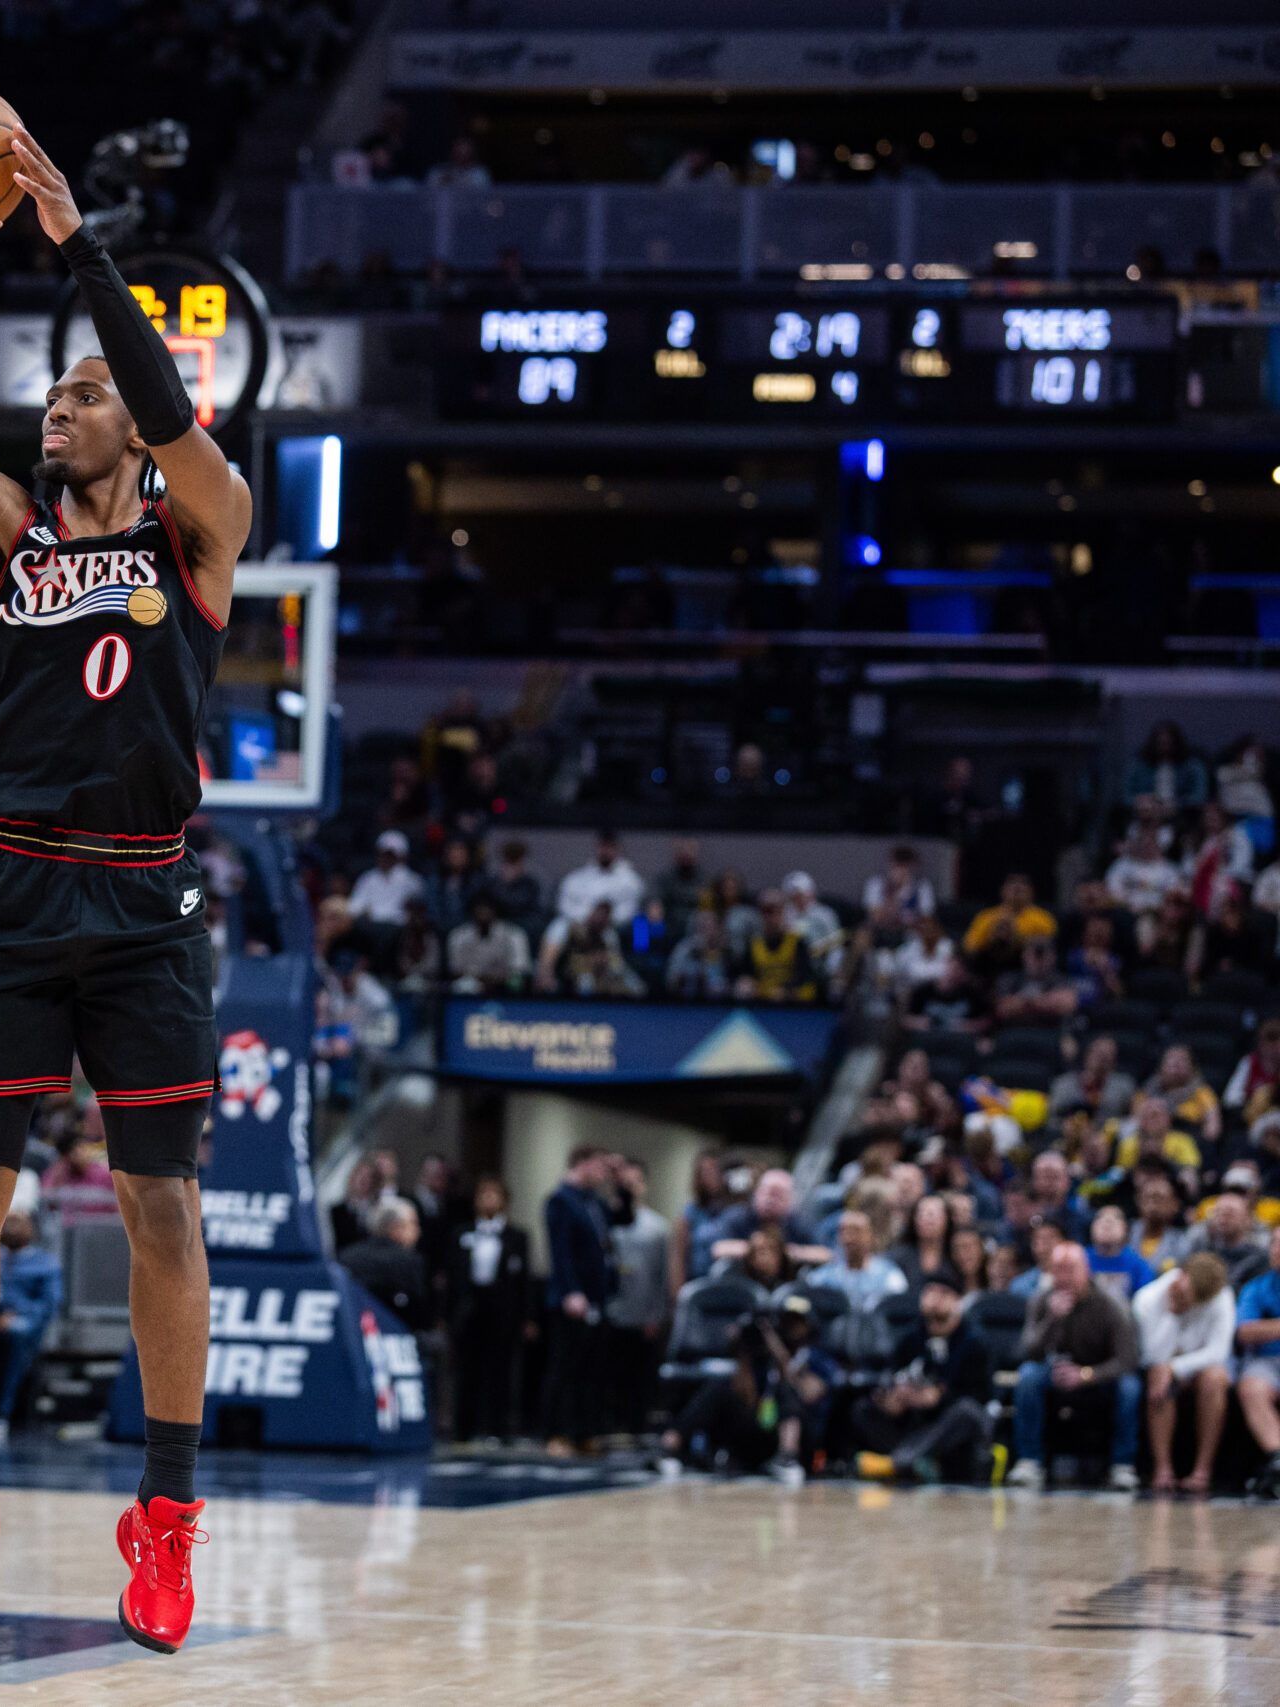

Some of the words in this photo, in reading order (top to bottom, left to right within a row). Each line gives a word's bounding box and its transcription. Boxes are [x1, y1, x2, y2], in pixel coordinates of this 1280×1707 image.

[481, 311, 608, 352] PACERS
[770, 312, 860, 359] 2:19
[1003, 309, 1111, 350] 76ERS
[1031, 357, 1101, 404] 101
[82, 632, 132, 701] 0
[183, 888, 200, 906] NIKE
[464, 1012, 617, 1049] Elevance
[209, 1286, 340, 1342] ELLE
[204, 1342, 308, 1396] IRE
